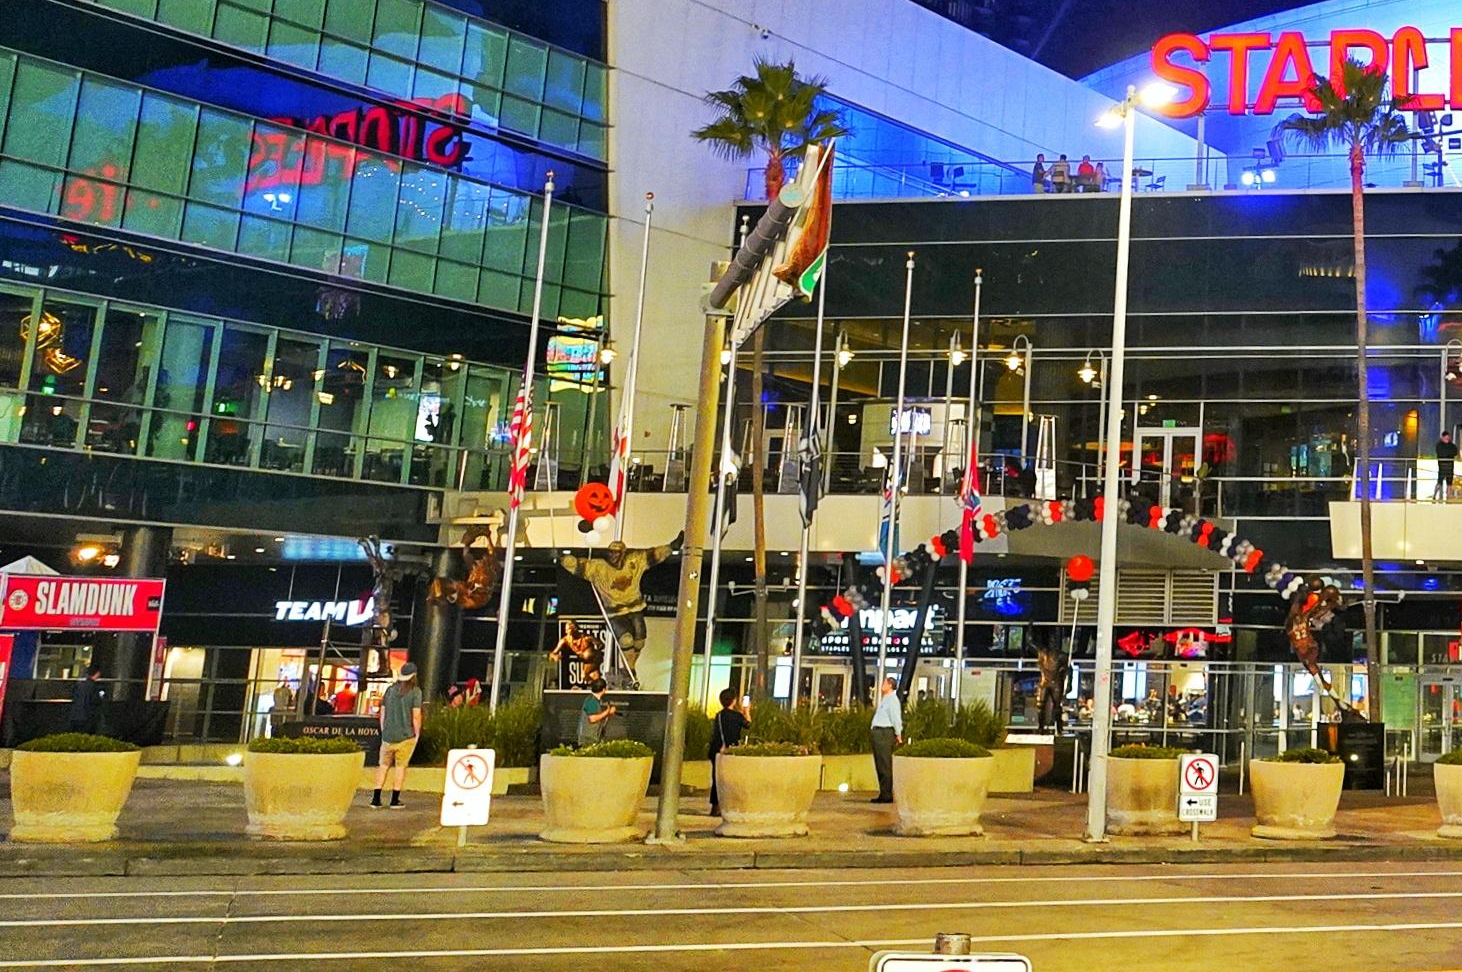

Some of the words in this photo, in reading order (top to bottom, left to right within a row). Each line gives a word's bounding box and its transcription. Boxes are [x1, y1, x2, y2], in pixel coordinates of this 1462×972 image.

[34, 581, 137, 616] SLAMDUNK
[275, 601, 348, 621] TEAM
[303, 726, 330, 735] OSCAR
[331, 727, 342, 735] DE
[345, 727, 356, 735] LA
[357, 728, 380, 736] HOYA
